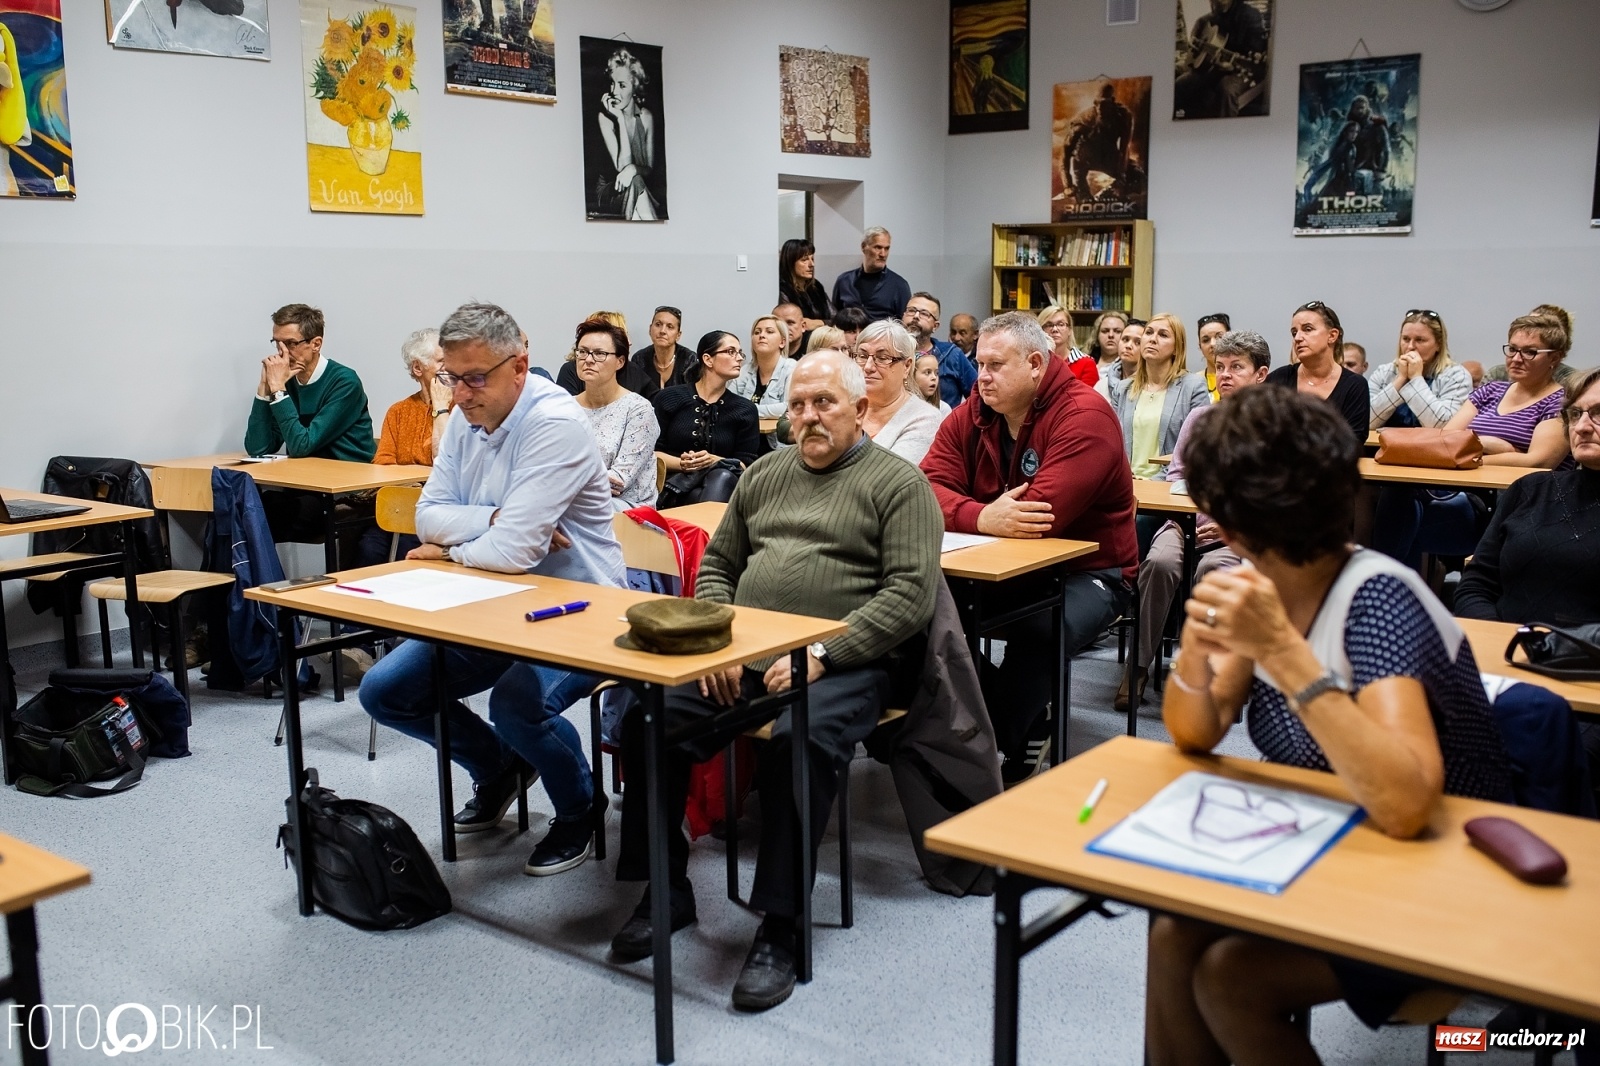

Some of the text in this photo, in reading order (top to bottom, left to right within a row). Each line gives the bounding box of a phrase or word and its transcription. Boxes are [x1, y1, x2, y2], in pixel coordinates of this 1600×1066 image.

[318, 177, 414, 211] Van Gogh
[1317, 194, 1384, 210] THOR
[1063, 201, 1137, 215] RIDDICK
